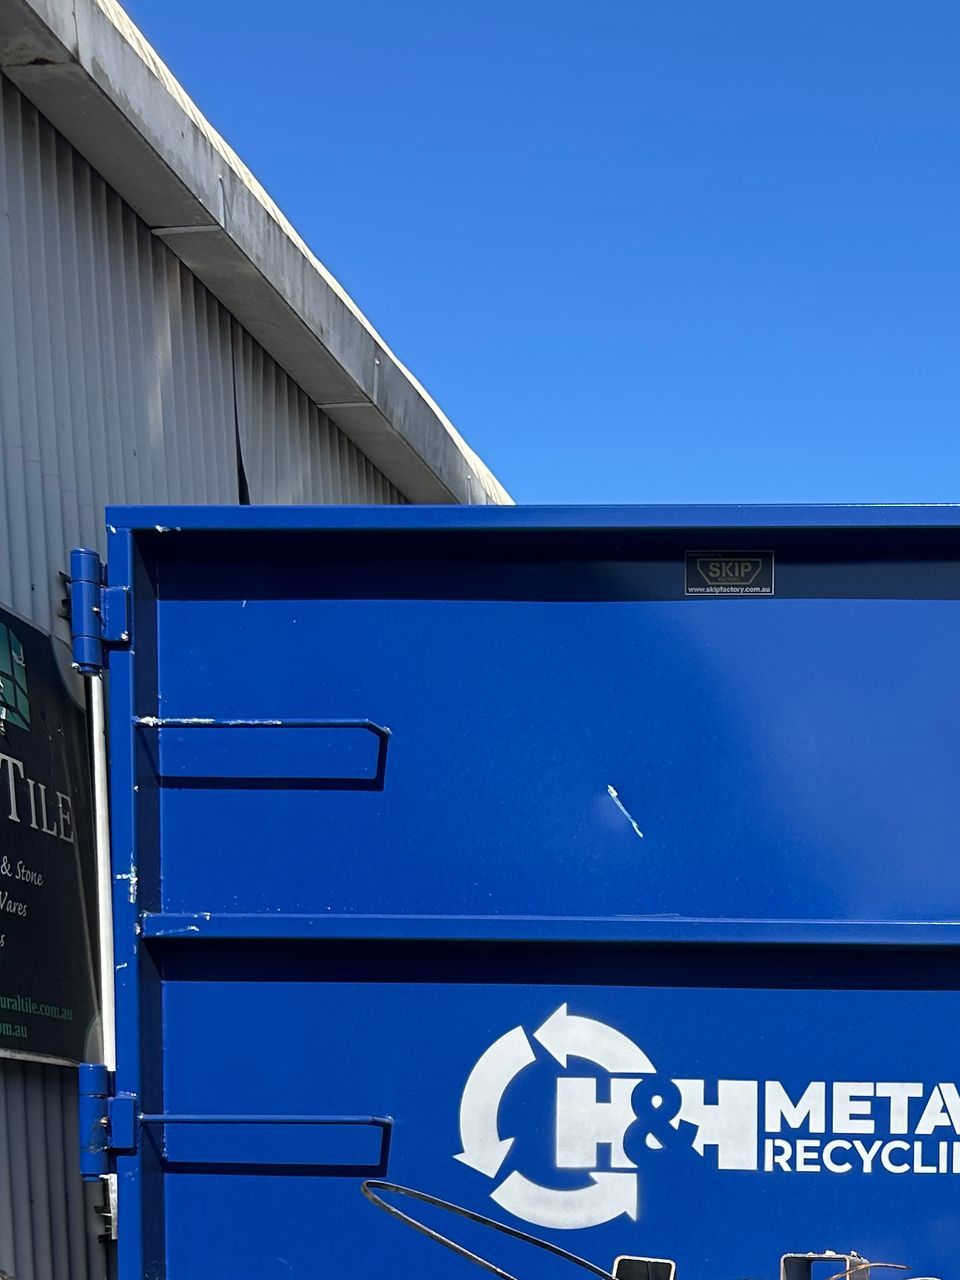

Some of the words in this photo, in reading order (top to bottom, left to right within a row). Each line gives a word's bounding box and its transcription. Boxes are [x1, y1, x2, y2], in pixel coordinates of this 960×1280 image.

[708, 562, 752, 578] SKIP
[688, 586, 771, 594] www.skipfactory.com.au
[0, 752, 75, 844] TILE
[0, 855, 13, 877] &
[15, 860, 45, 886] Stone
[556, 1076, 758, 1170] H&H
